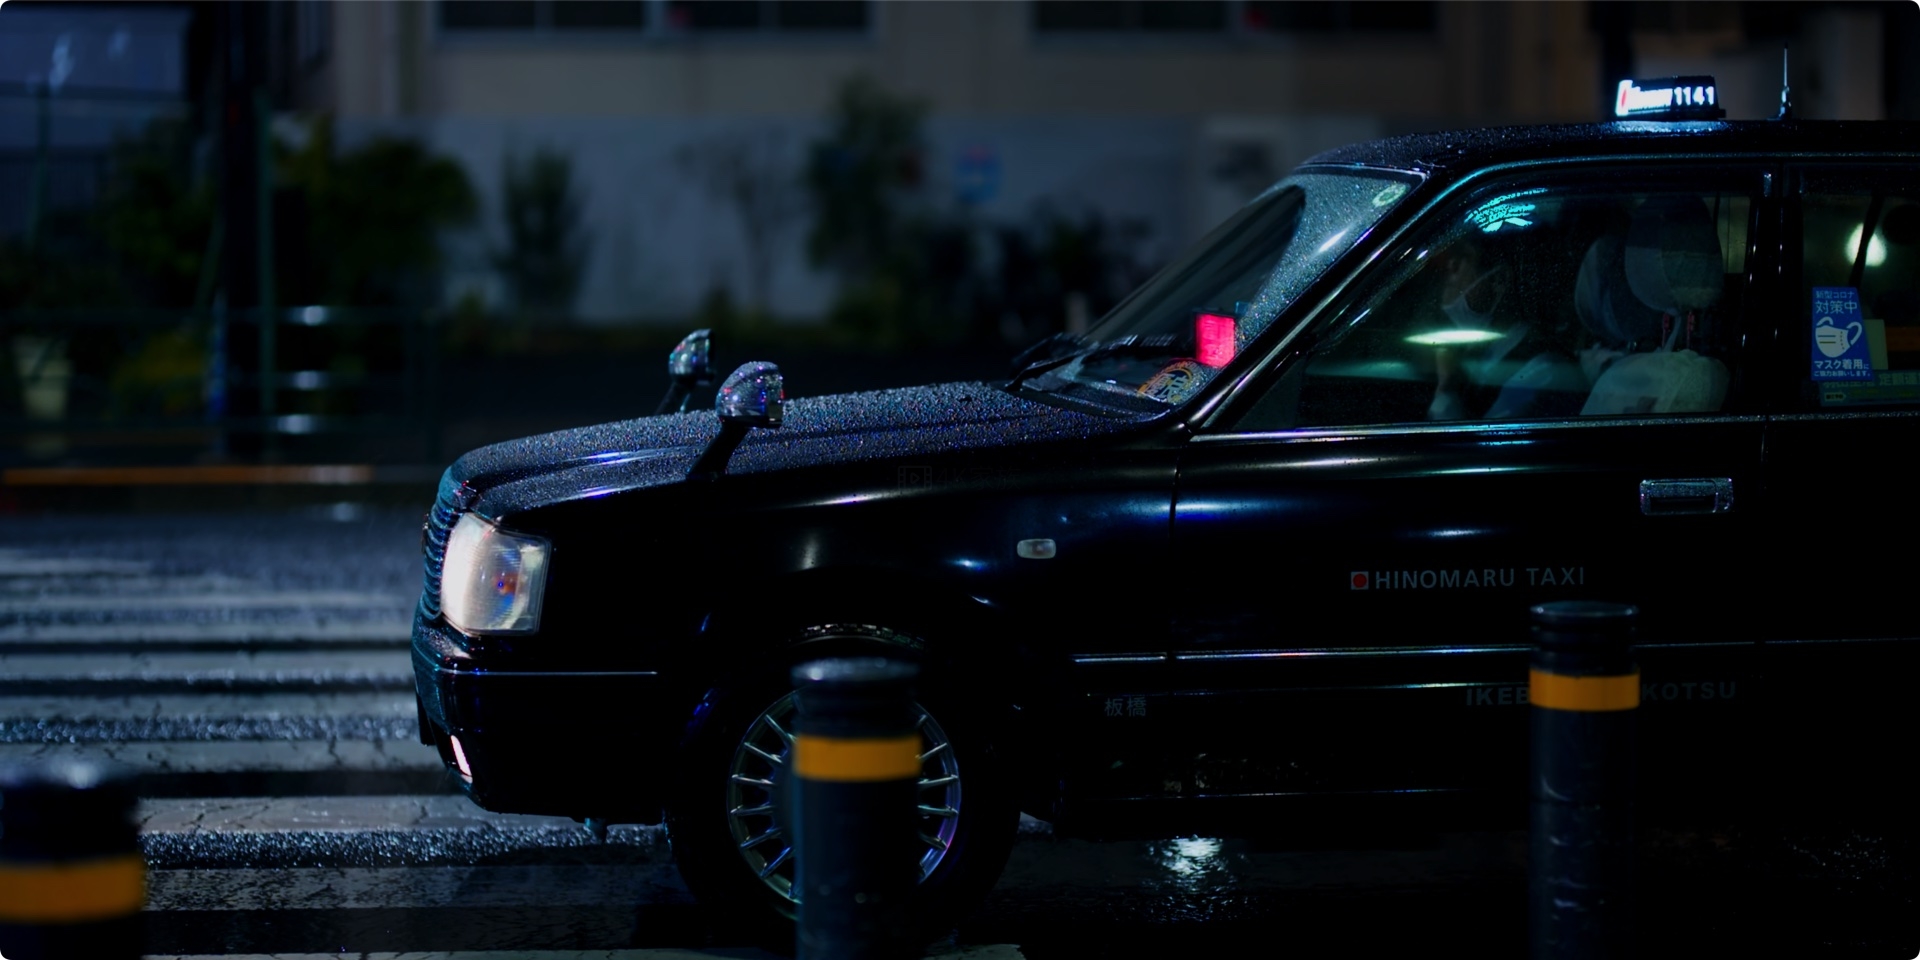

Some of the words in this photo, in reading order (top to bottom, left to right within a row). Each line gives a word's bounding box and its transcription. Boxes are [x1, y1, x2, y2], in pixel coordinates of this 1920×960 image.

[1674, 86, 1715, 106] 1141
[1815, 290, 1855, 299] 新型コロナ
[1815, 300, 1858, 314] 対策中
[1814, 359, 1870, 370] マスク着用に
[1375, 568, 1515, 590] HINOMARU
[1525, 566, 1585, 587] TAXI
[1466, 686, 1530, 706] IKEB
[1642, 681, 1737, 701] KOTSU
[1104, 696, 1147, 717] 板橋
